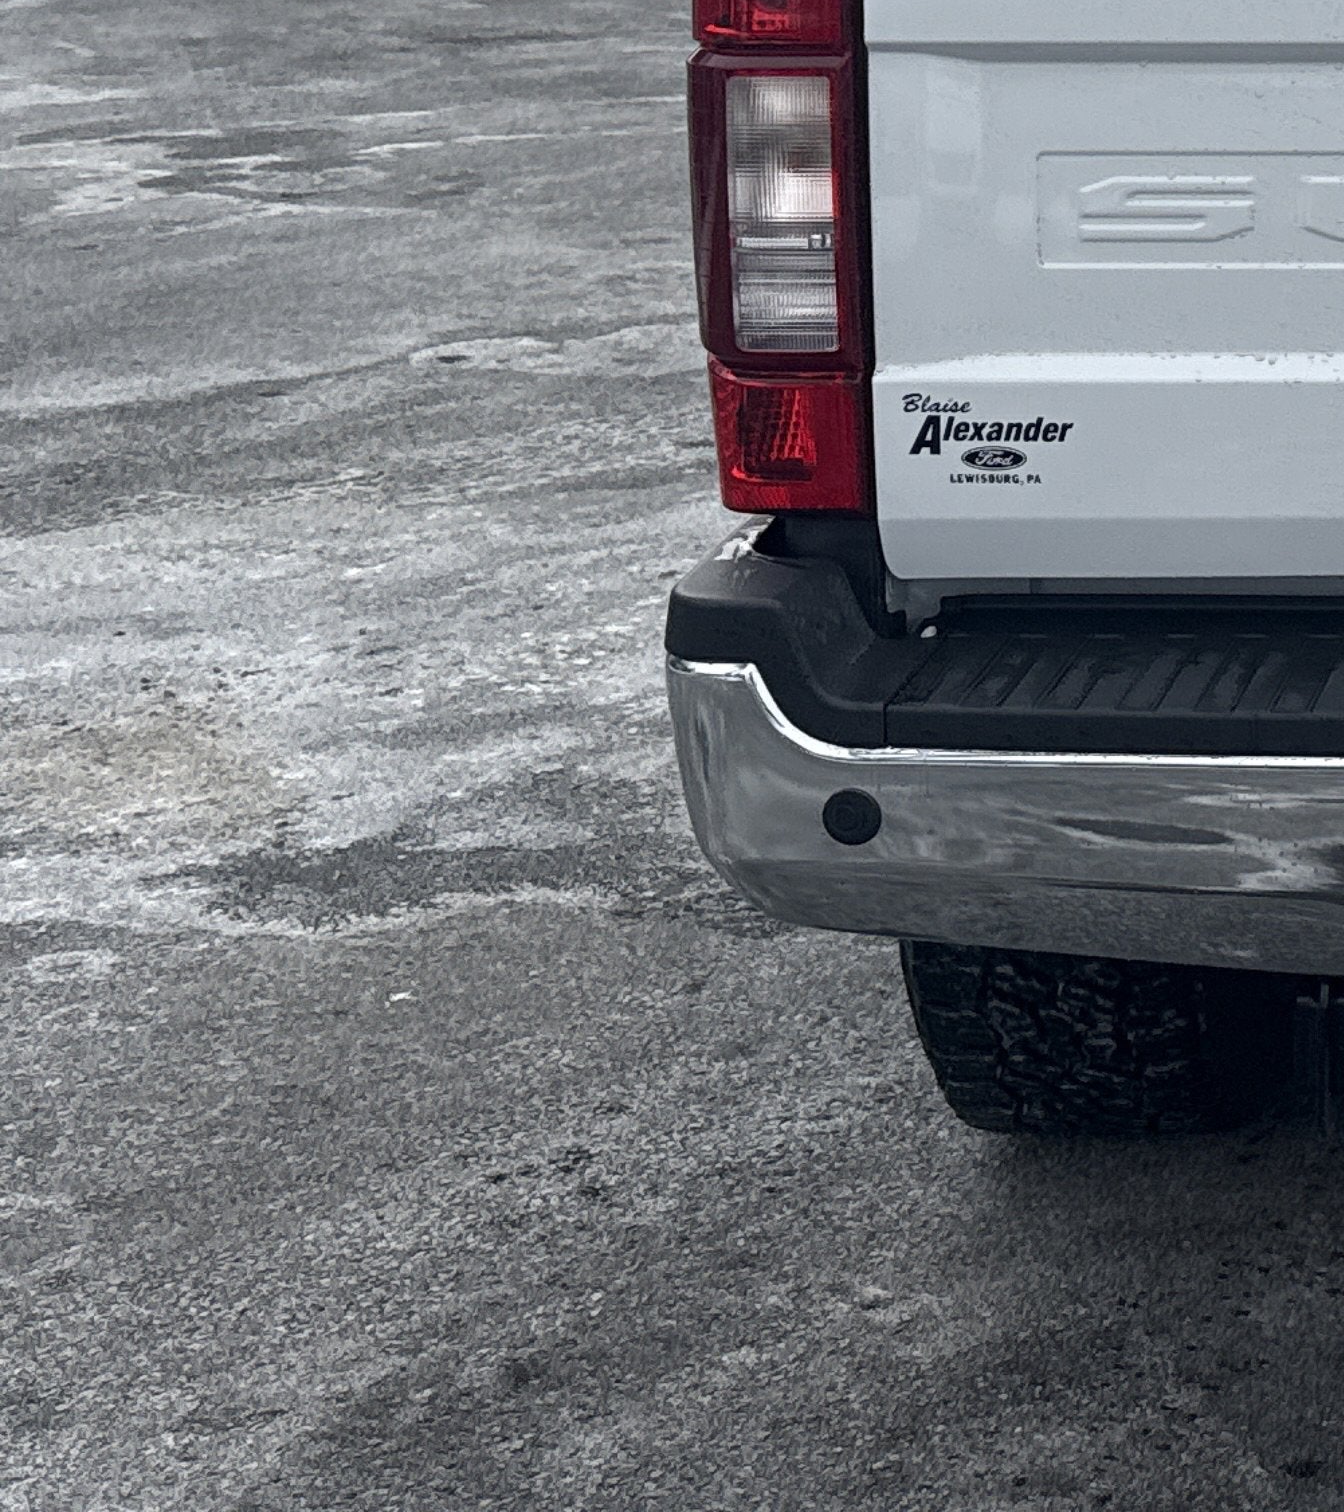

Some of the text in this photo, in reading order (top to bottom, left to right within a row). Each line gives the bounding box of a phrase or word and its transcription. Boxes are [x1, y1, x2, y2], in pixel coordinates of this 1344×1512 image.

[902, 393, 972, 413] Blaise
[909, 415, 1075, 455] Alexander
[975, 450, 1015, 466] Ford
[950, 473, 1042, 486] LEWISBURG, PA
